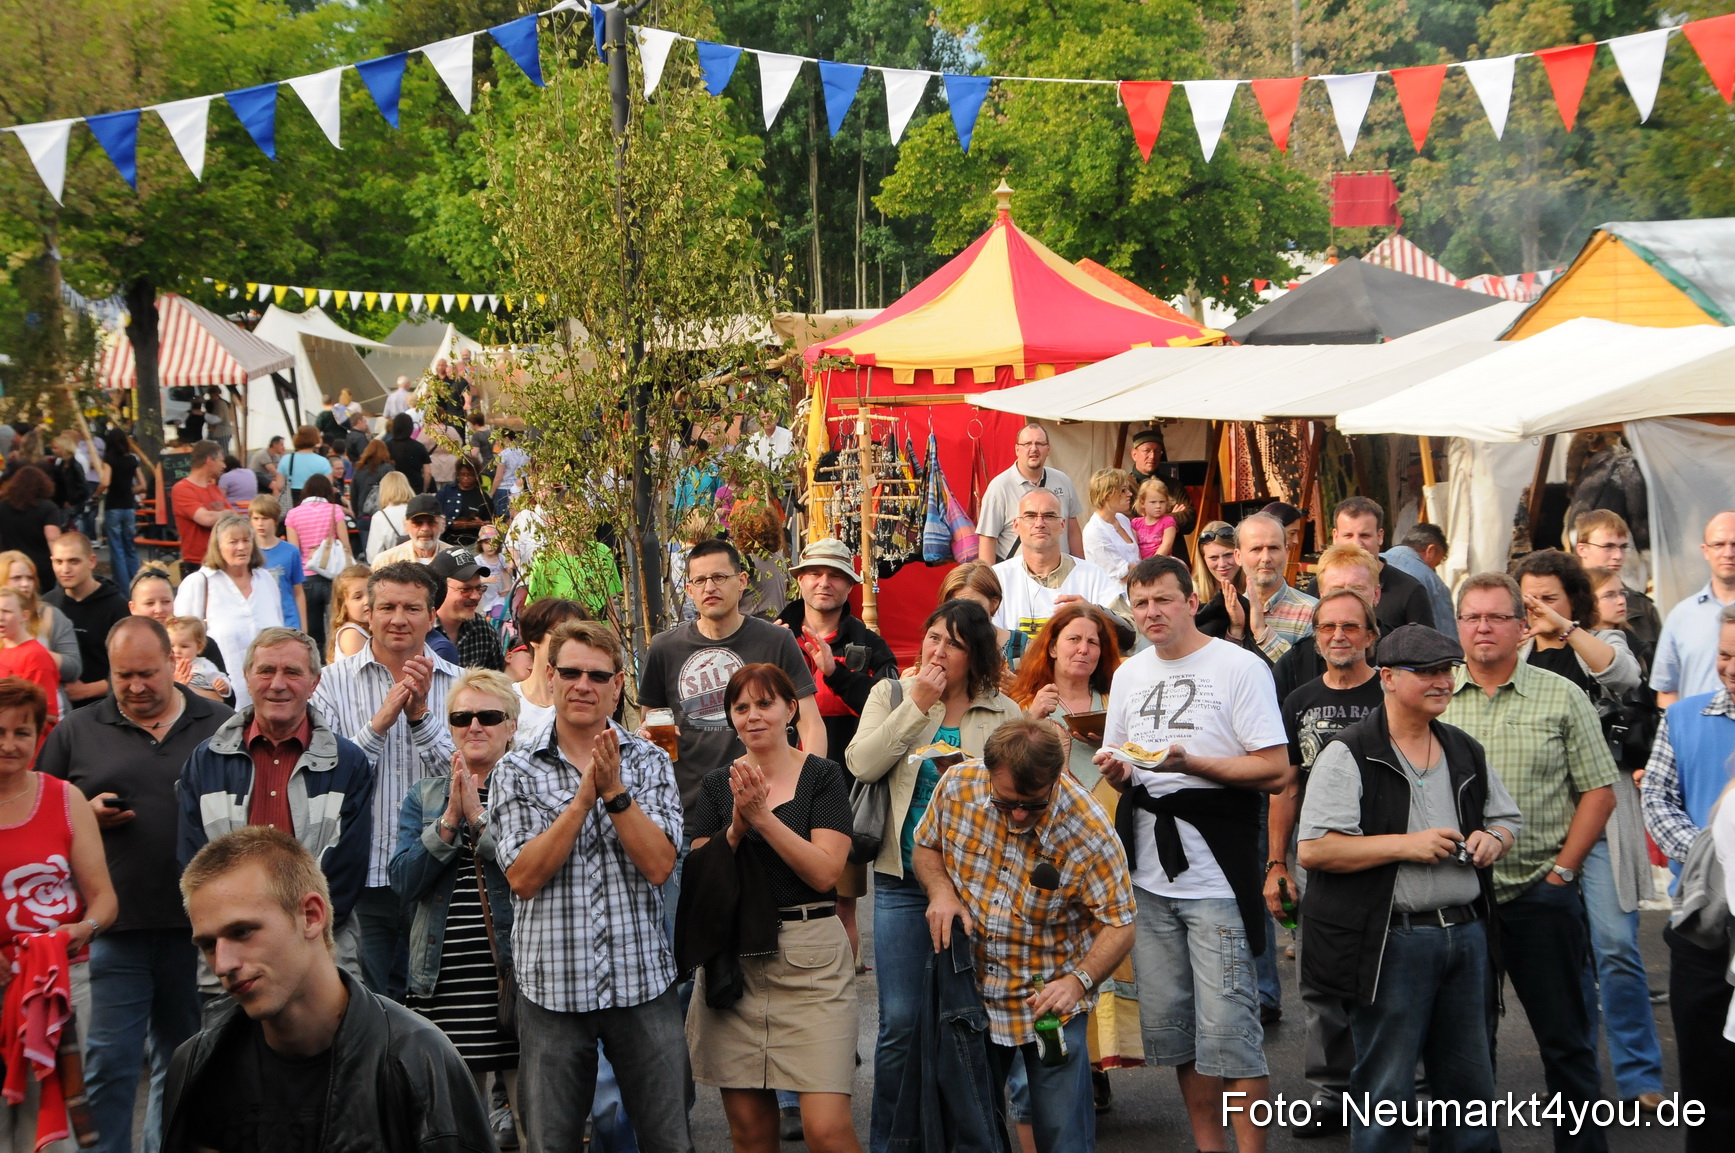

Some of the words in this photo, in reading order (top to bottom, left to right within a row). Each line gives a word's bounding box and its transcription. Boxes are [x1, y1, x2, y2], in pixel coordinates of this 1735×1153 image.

[685, 662, 736, 695] SALT
[701, 691, 725, 708] LAK
[1140, 679, 1195, 730] 42
[1189, 703, 1221, 711] ourtytwo
